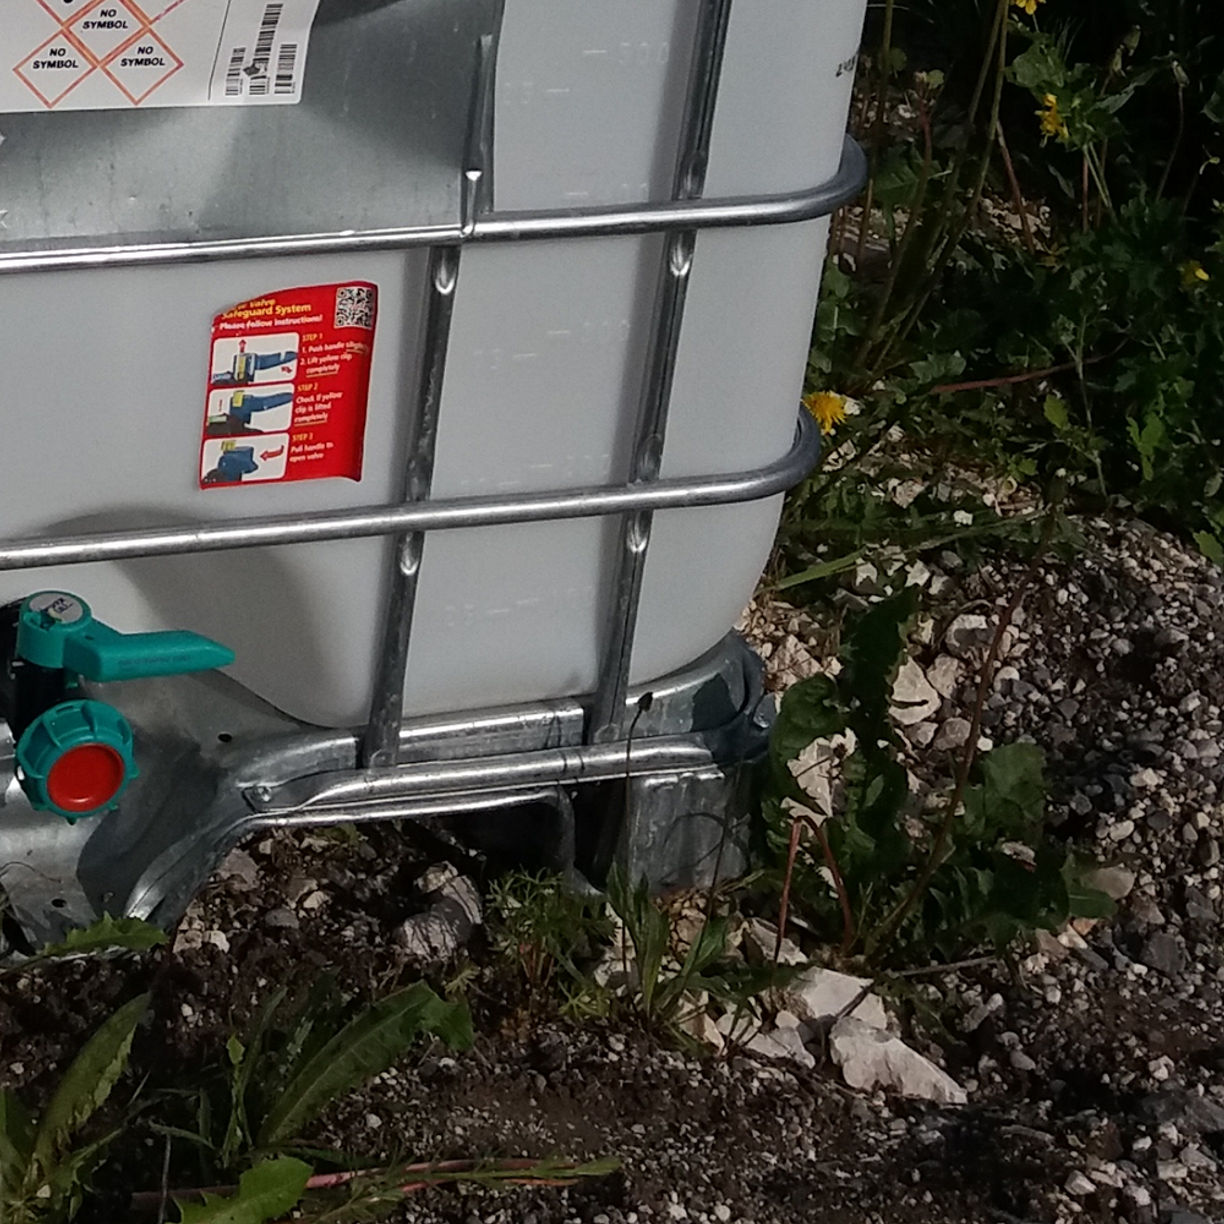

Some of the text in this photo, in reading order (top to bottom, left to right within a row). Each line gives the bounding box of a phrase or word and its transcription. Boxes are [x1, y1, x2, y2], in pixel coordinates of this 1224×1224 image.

[100, 9, 117, 17] NO
[82, 20, 128, 29] SYMBOL
[49, 48, 66, 57] NO
[137, 46, 154, 55] NO
[32, 60, 79, 69] SYMBOL
[120, 58, 165, 67] SYMBOL
[275, 304, 311, 316] System
[219, 322, 245, 330] Please
[246, 320, 272, 329] follow
[302, 334, 317, 342] STEP
[308, 345, 323, 353] Push
[324, 341, 345, 351] handle
[319, 354, 339, 364] yellow
[297, 384, 313, 392] STEP
[296, 395, 315, 404] Check
[292, 433, 308, 442] STEP
